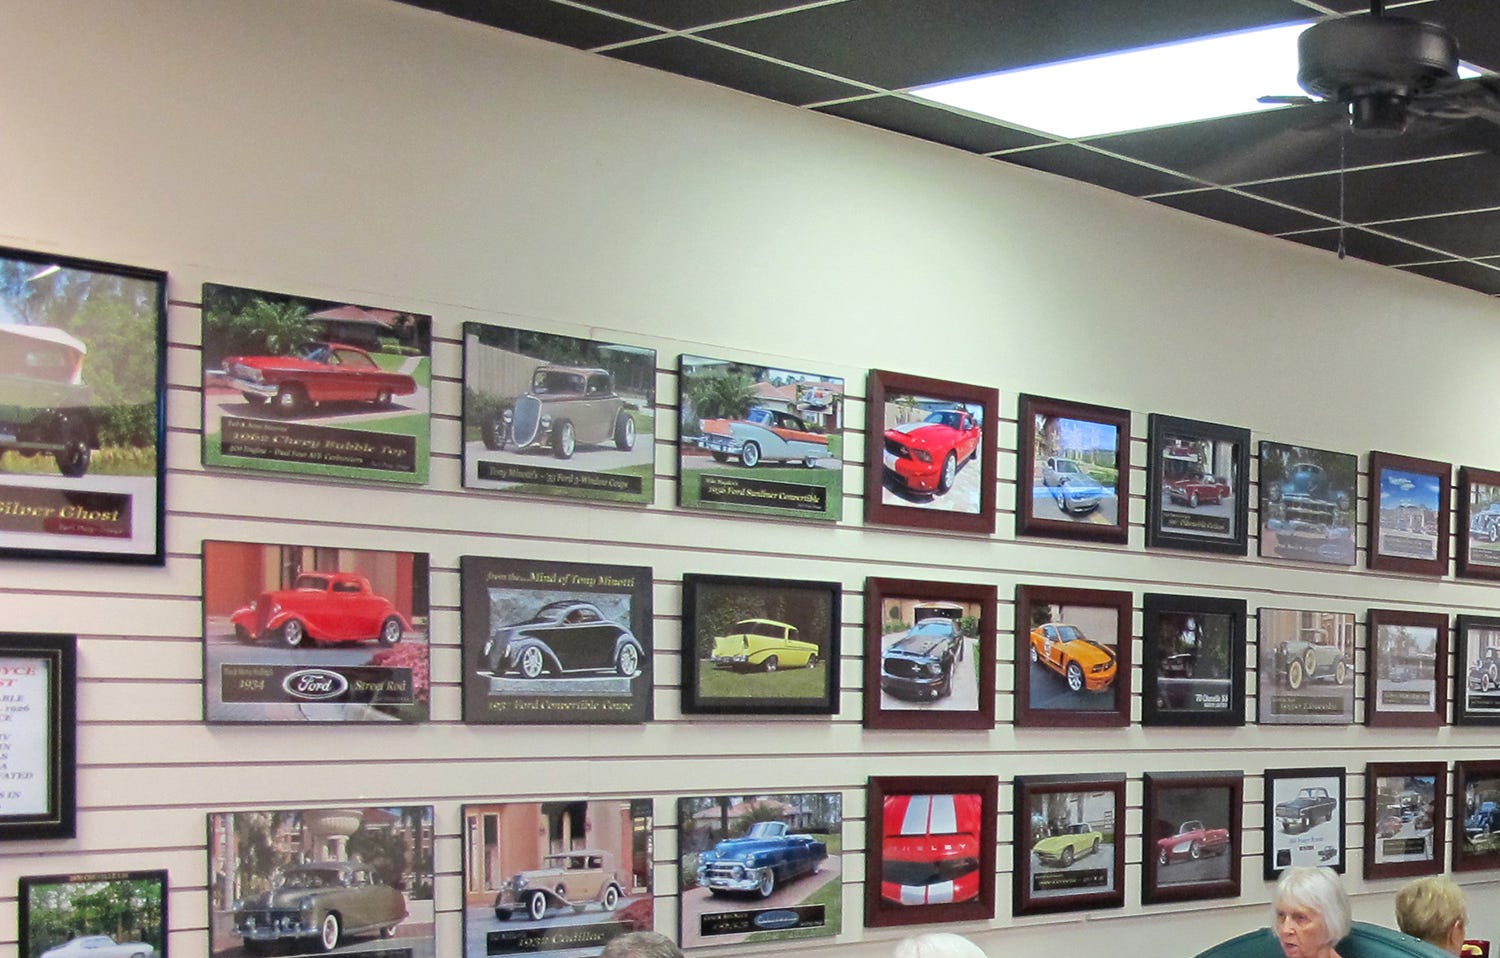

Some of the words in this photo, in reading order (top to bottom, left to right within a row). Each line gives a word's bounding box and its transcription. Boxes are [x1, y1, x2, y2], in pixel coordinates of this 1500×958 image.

[727, 488, 745, 497] Ford
[58, 504, 120, 522] Ghost
[558, 574, 569, 586] of
[297, 674, 333, 692] Ford
